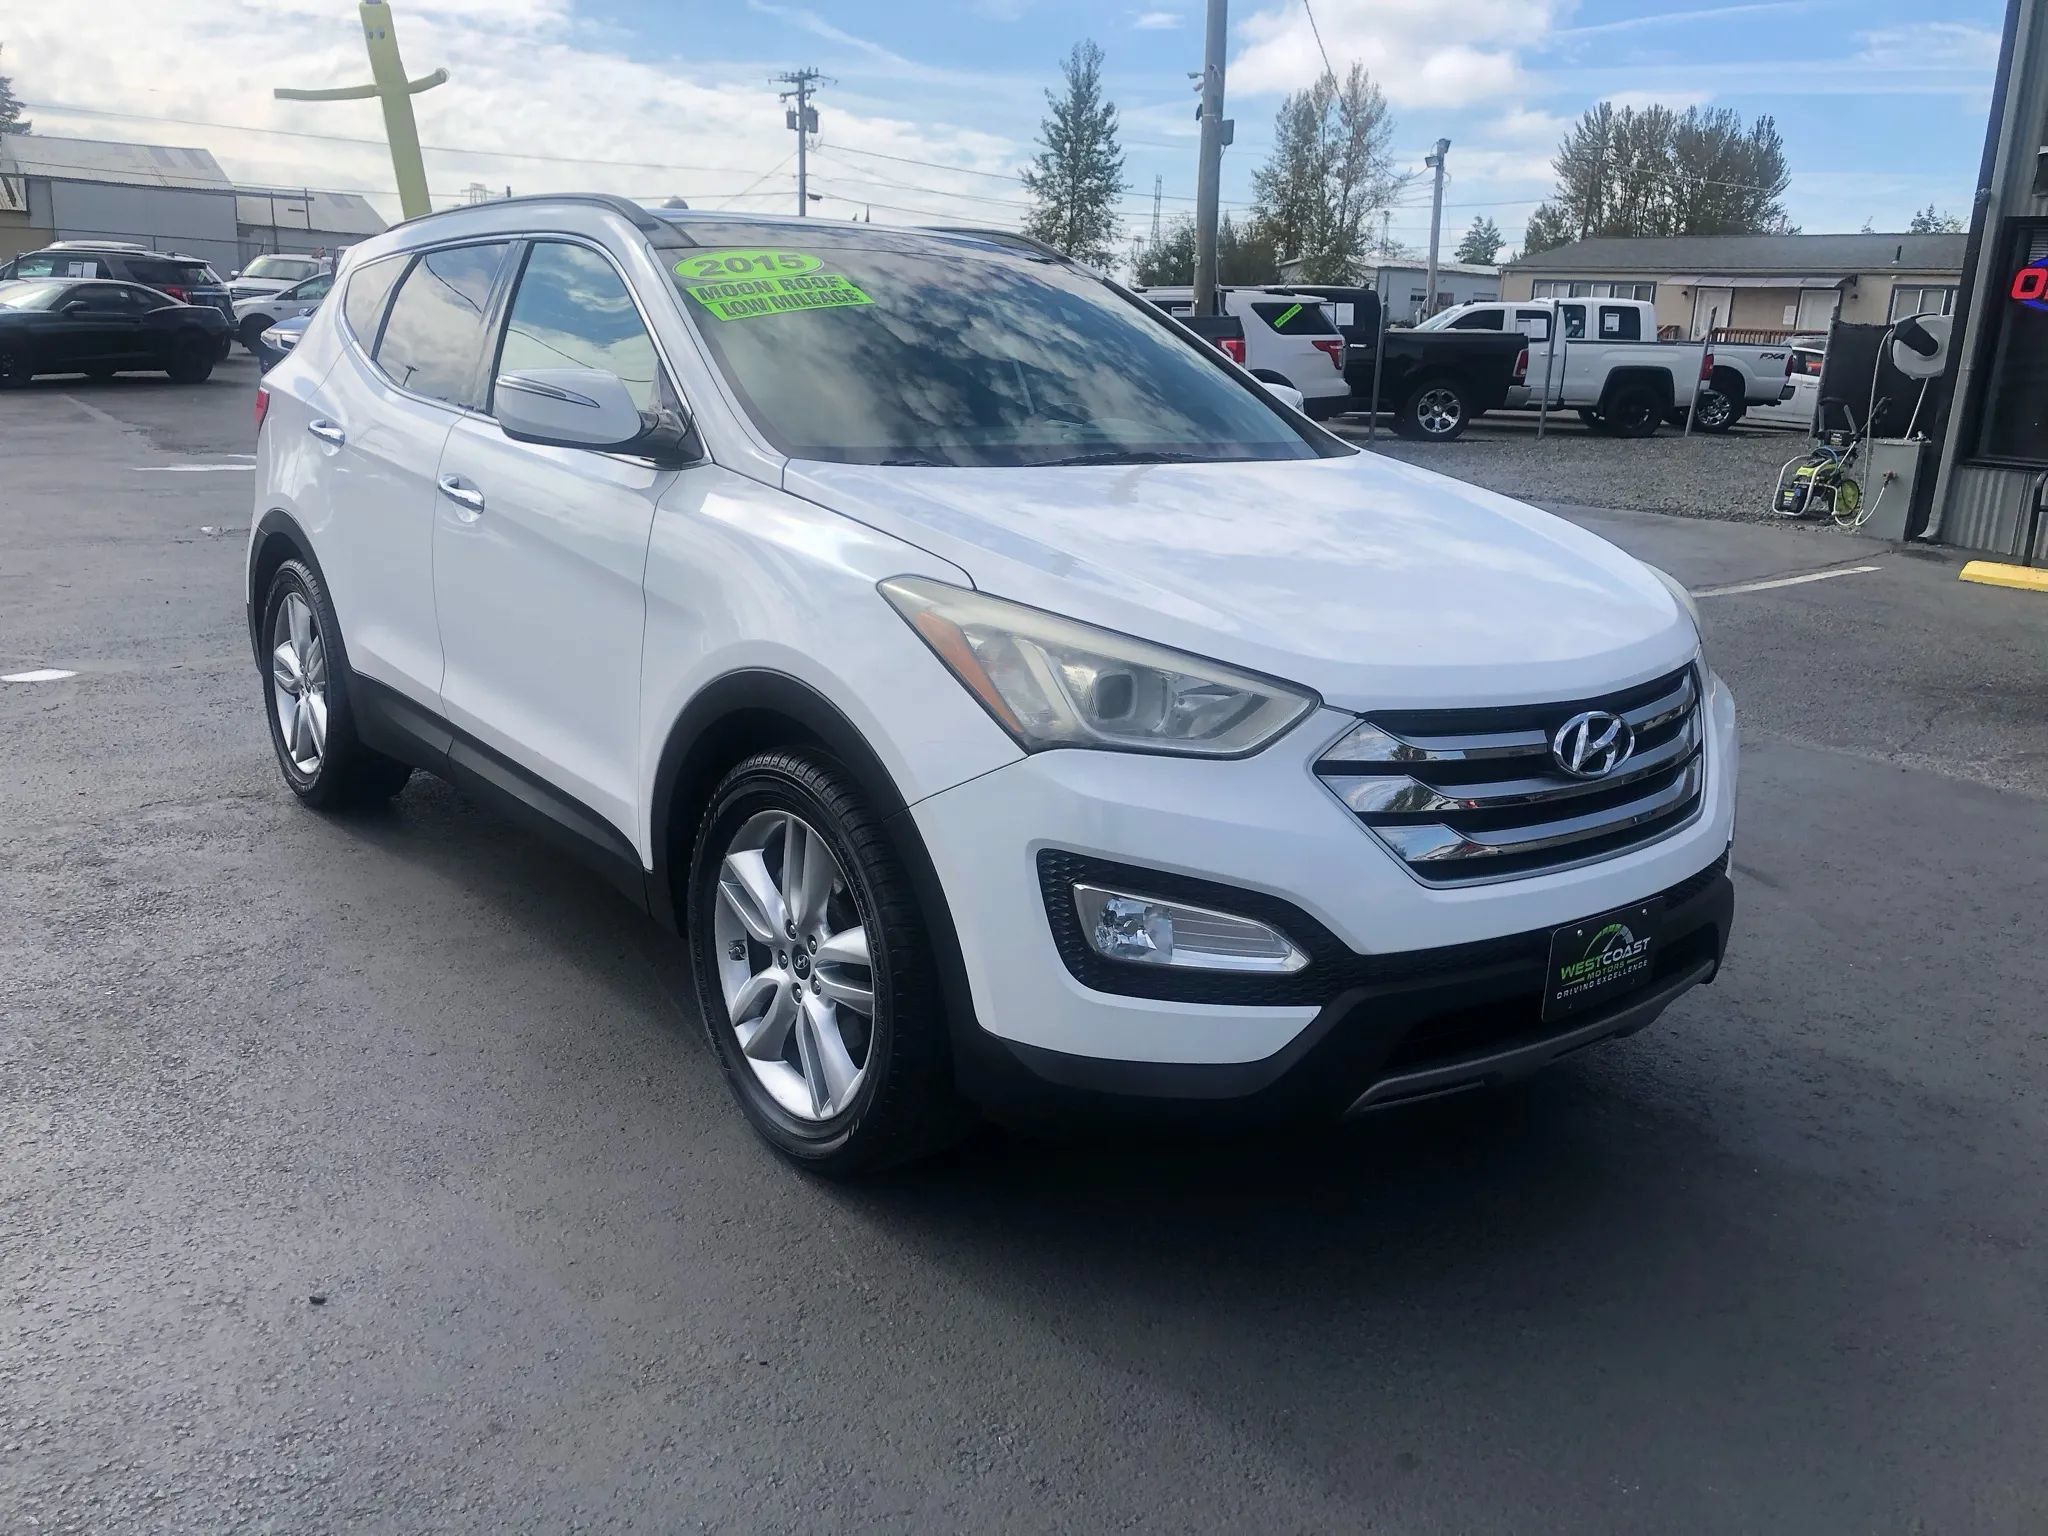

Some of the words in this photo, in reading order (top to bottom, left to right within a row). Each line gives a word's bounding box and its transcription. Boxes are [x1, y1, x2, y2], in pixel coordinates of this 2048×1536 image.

[694, 254, 806, 277] 2015
[697, 280, 774, 300] MOON
[778, 276, 840, 291] ROOF
[718, 298, 771, 317] LOW
[769, 289, 862, 309] MILEAGE
[1760, 352, 1786, 360] FX4
[1556, 980, 1595, 1000] DRIVING
[1596, 959, 1648, 985] EXCELLENCE
[1587, 961, 1625, 980] MOTORS
